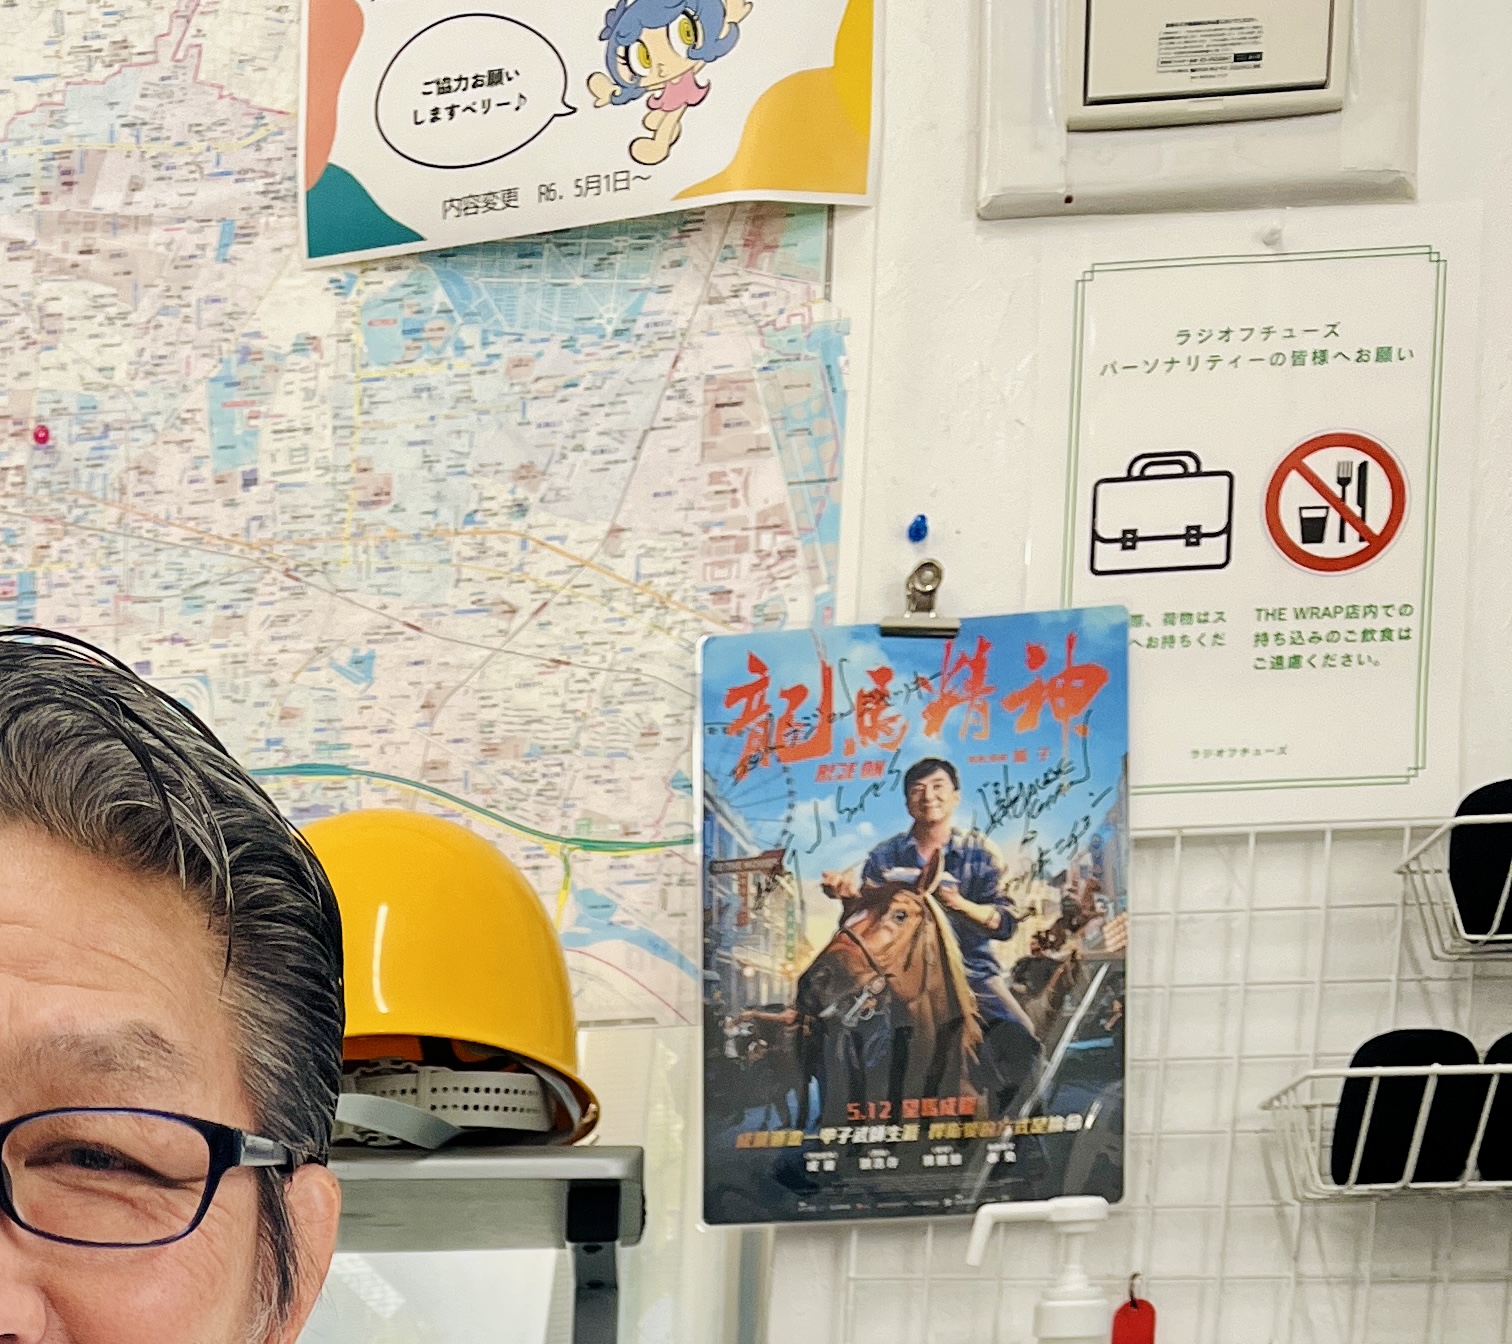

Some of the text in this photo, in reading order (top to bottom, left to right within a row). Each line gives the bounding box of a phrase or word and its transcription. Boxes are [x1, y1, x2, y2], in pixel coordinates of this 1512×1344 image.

[421, 68, 521, 96] ご協力お願い
[442, 186, 519, 220] 内容変更
[1175, 321, 1341, 345] ラジオフチューズ
[1099, 346, 1415, 377] パーソナリティーの皆様へお願い
[1255, 607, 1288, 622] THE
